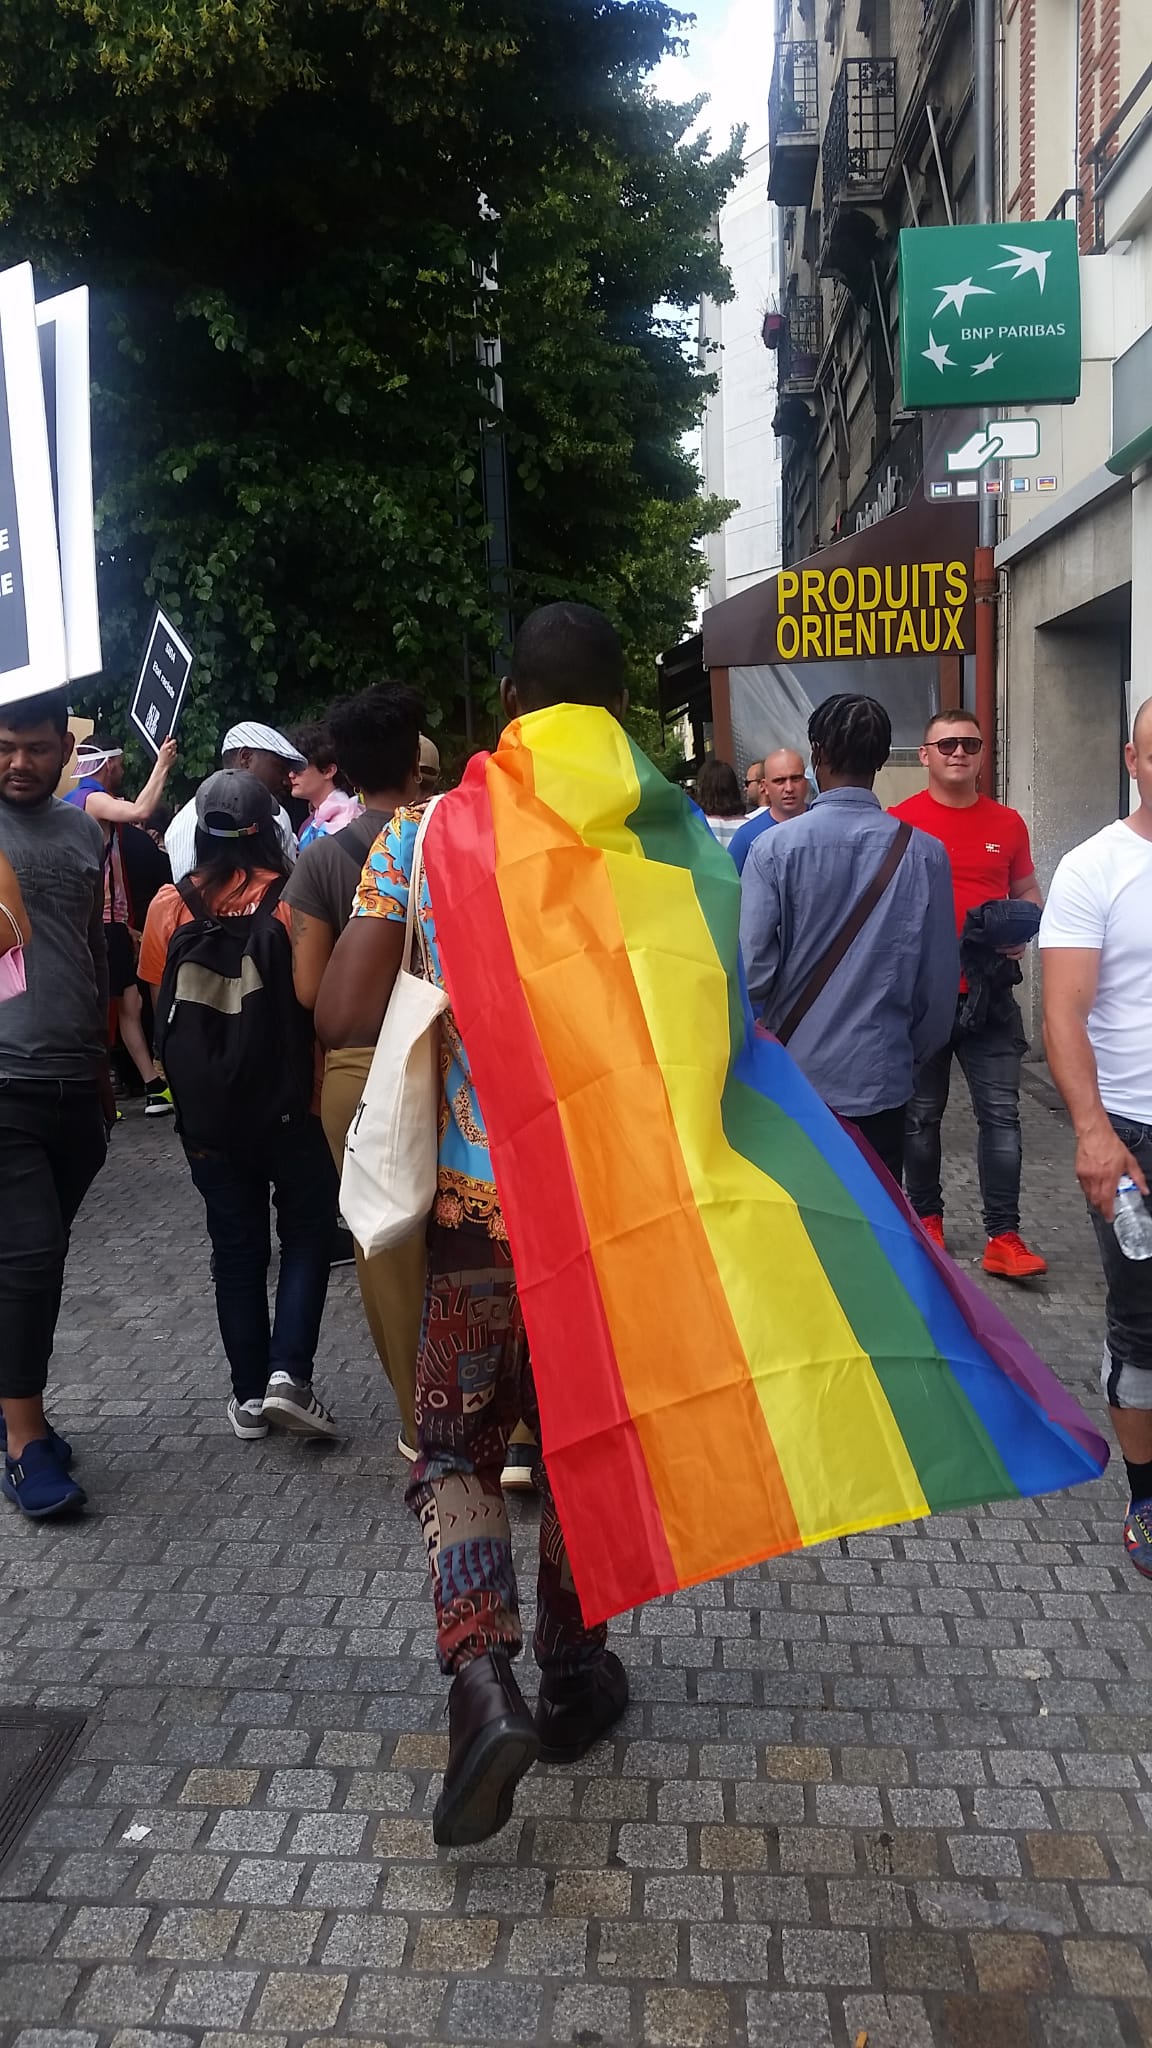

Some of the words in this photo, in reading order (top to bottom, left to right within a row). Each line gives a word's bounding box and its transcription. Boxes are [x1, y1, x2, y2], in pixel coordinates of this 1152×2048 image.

[961, 327, 994, 340] BNP
[998, 323, 1066, 339] PARIBAS
[777, 561, 968, 614] PRODUITS
[776, 606, 965, 660] ORIENTAUX
